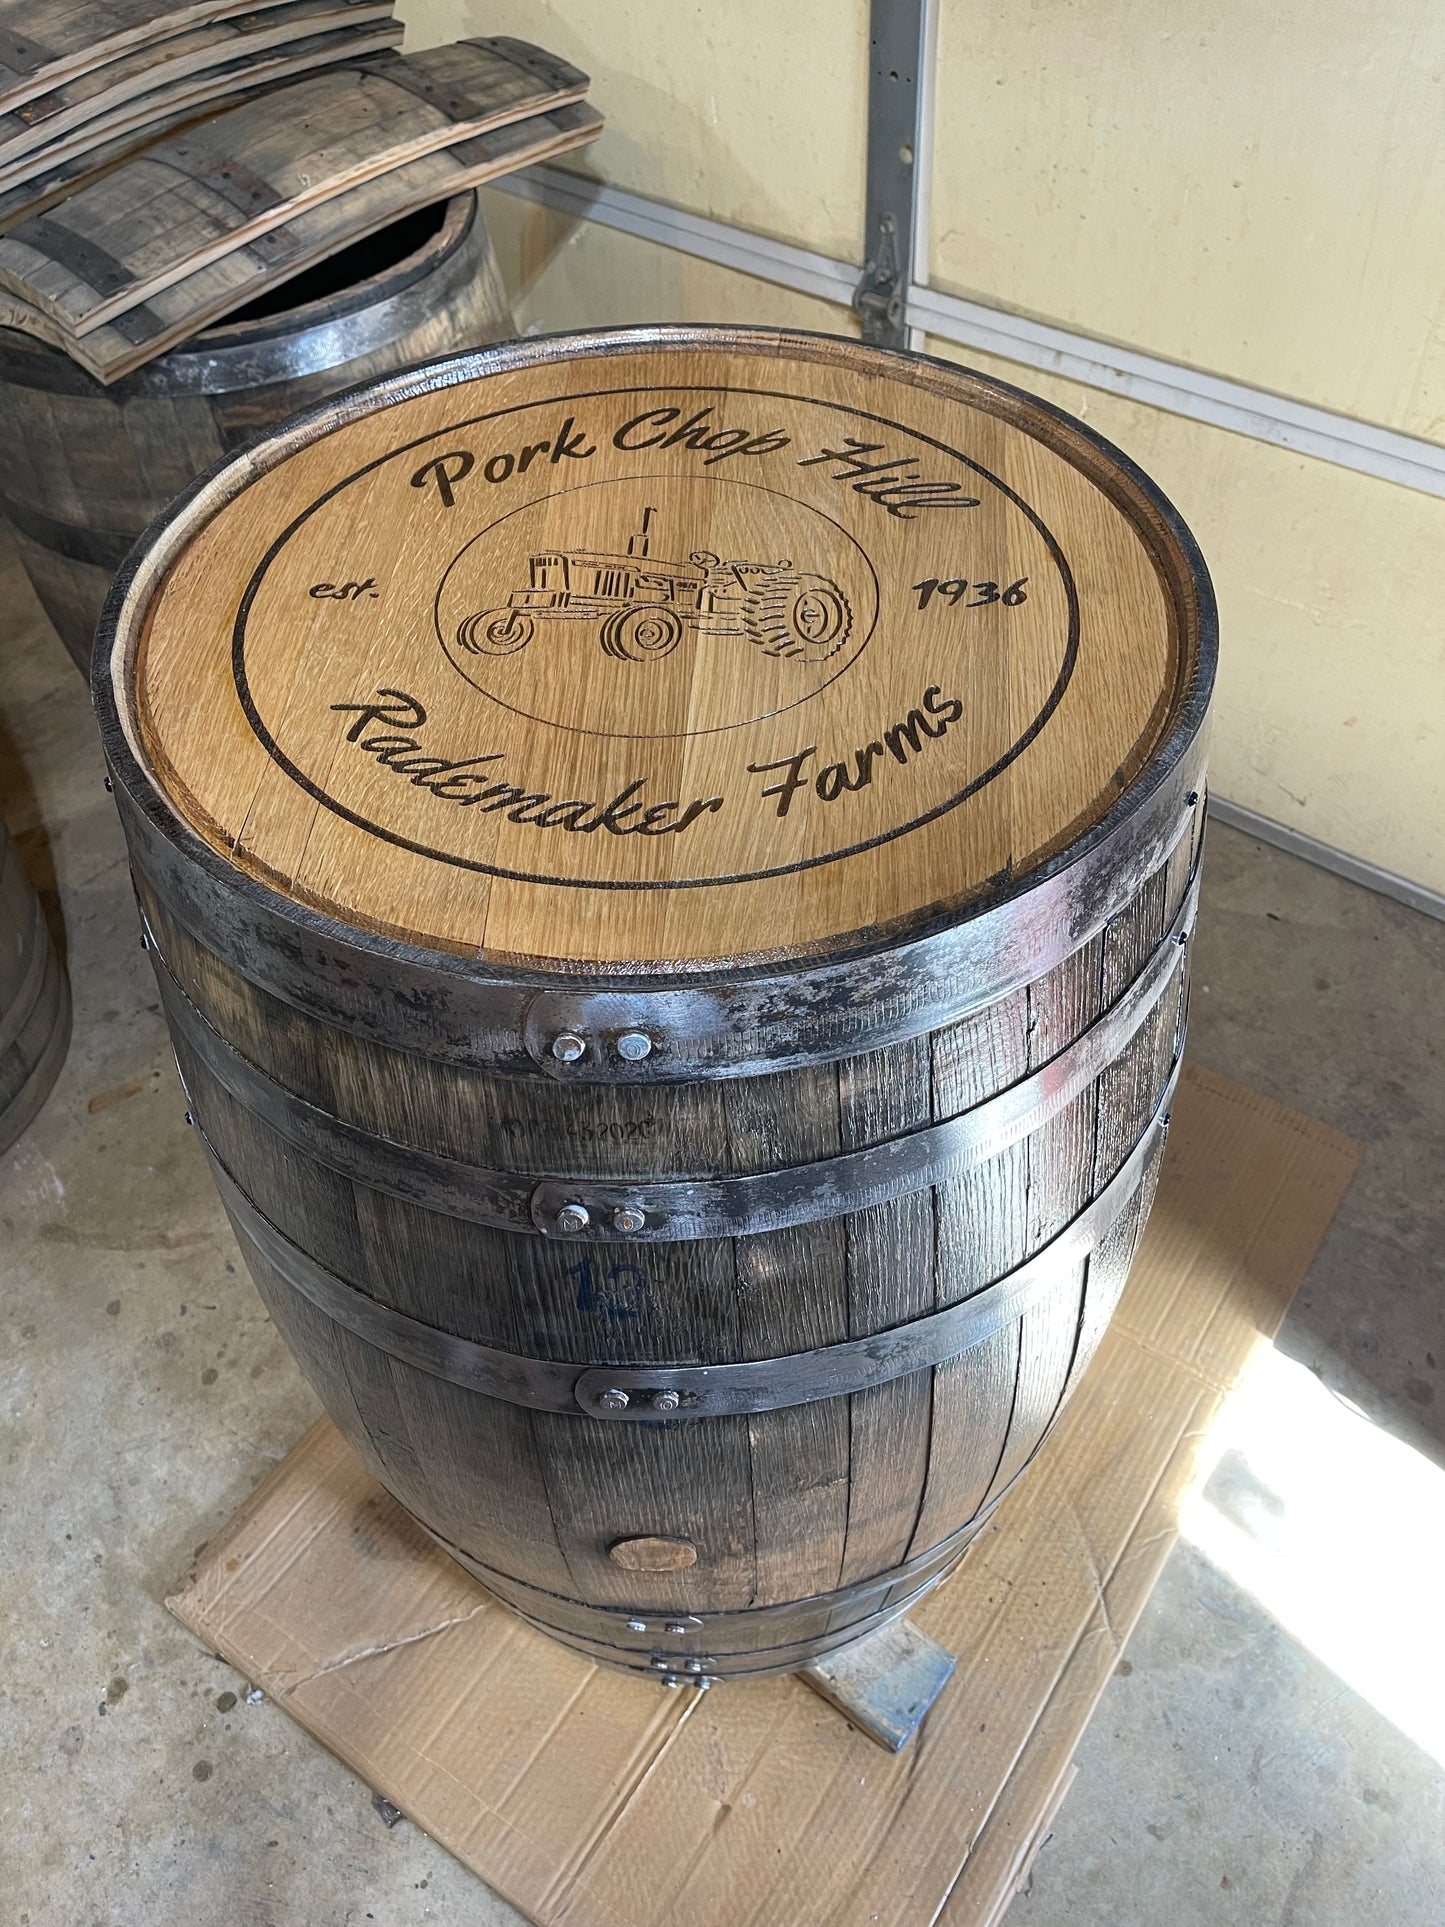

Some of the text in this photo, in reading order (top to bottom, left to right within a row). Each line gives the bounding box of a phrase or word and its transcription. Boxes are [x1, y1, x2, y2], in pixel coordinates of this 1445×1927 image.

[410, 406, 981, 519] Pork Chop Hill
[911, 577, 1029, 611] 1936
[329, 684, 963, 836] Rademaker Farms
